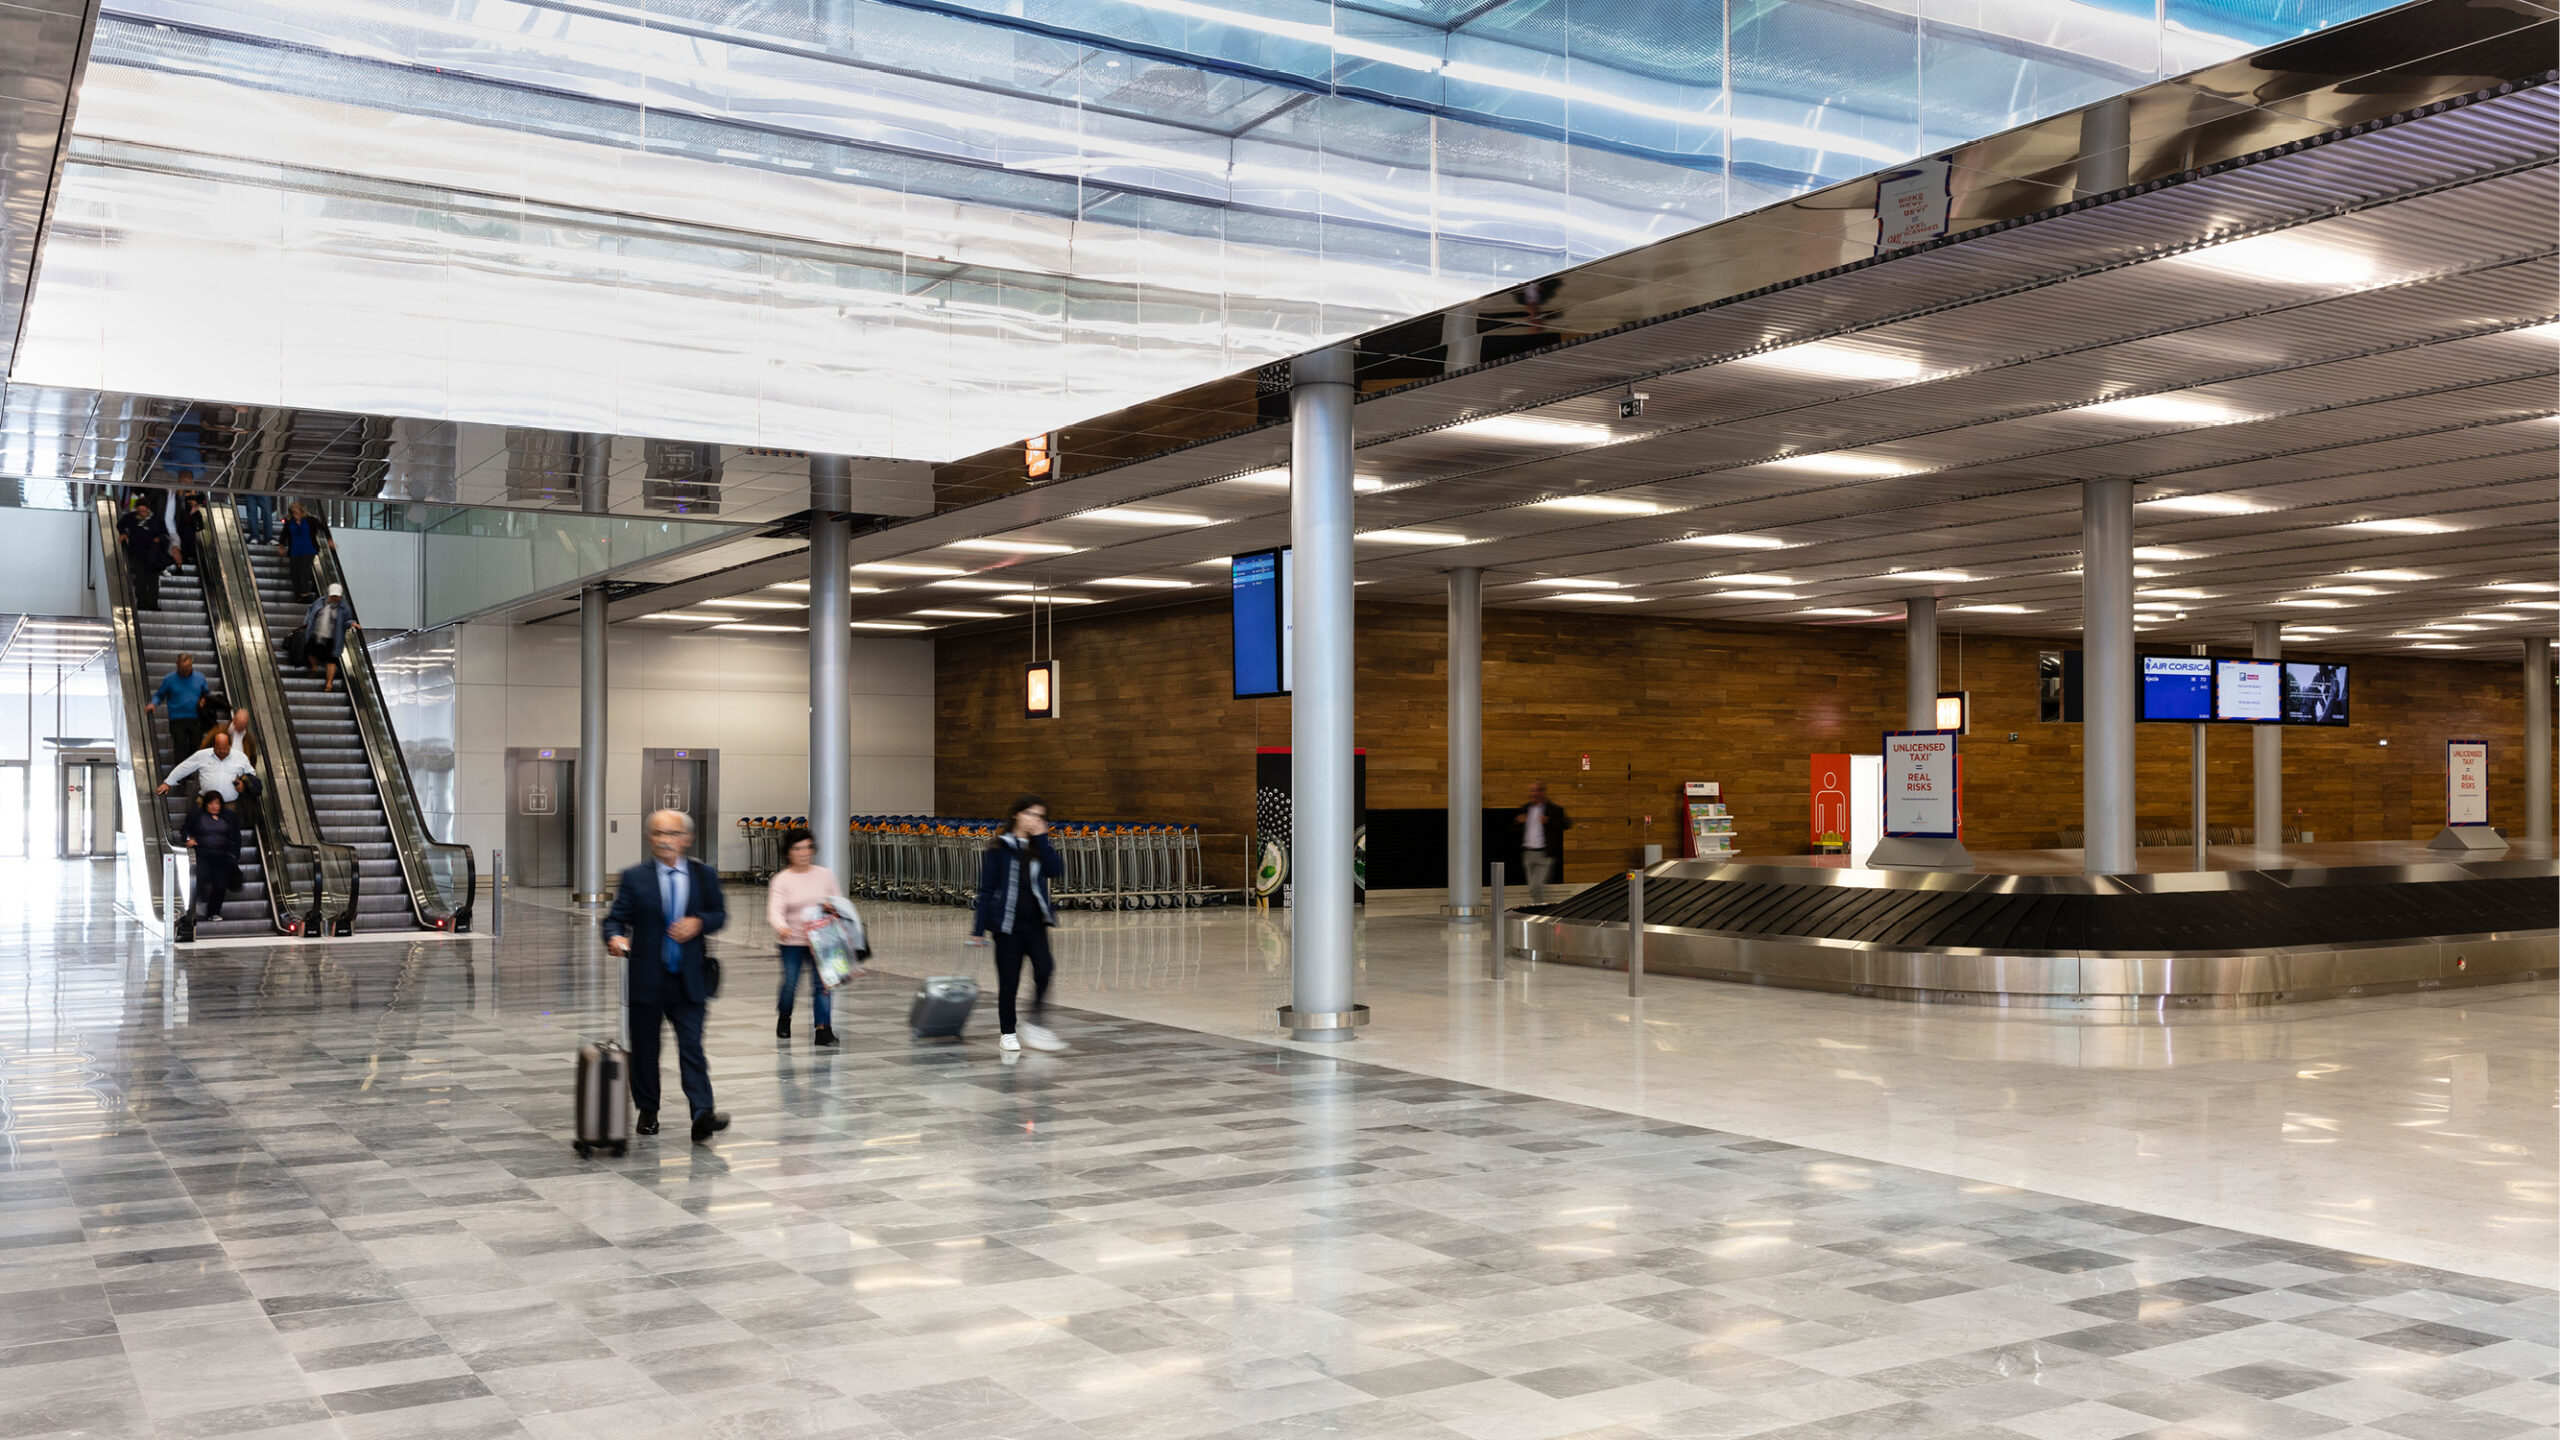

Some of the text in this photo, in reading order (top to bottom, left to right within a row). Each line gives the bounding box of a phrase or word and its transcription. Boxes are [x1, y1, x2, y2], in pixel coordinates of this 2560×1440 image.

[2168, 663, 2211, 671] CORSICA
[1893, 743, 1946, 752] UNLICENSED
[1908, 773, 1931, 781] REAL
[1907, 783, 1932, 791] RISKS
